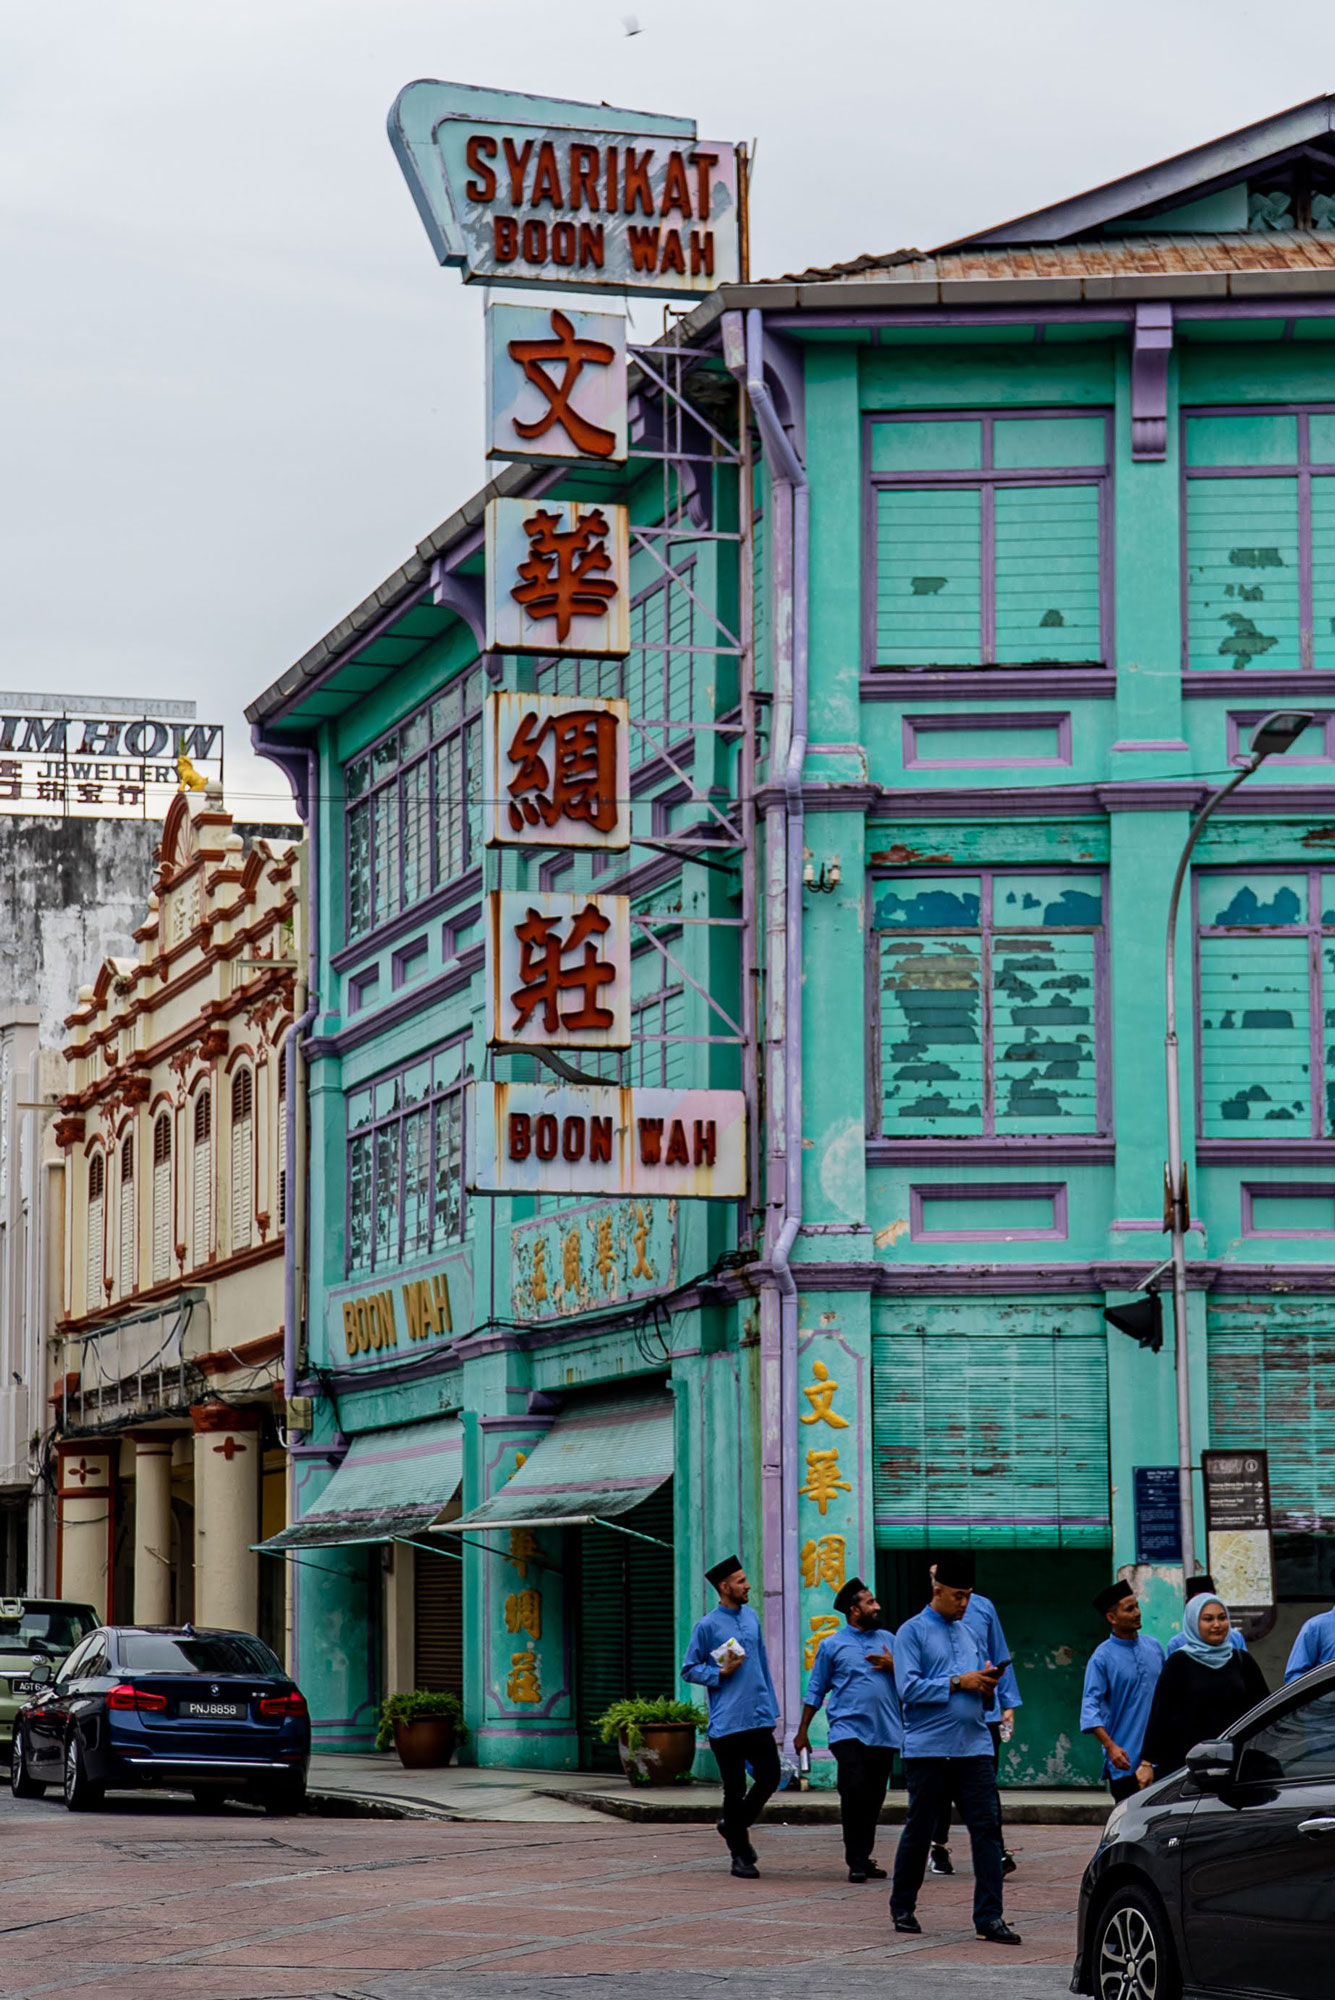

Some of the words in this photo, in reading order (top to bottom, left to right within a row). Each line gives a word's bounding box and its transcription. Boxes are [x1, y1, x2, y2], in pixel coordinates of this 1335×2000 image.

[466, 135, 719, 220] SYARIKAT
[493, 215, 604, 269] BOON
[627, 225, 714, 276] WAH
[76, 720, 223, 760] HOW
[37, 761, 181, 783] JEWELLERY
[508, 1113, 613, 1162] BOON
[637, 1117, 717, 1166] WAH
[342, 1290, 397, 1356] BOON
[402, 1272, 453, 1341] WAH
[190, 1703, 236, 1714] PNJ8858
